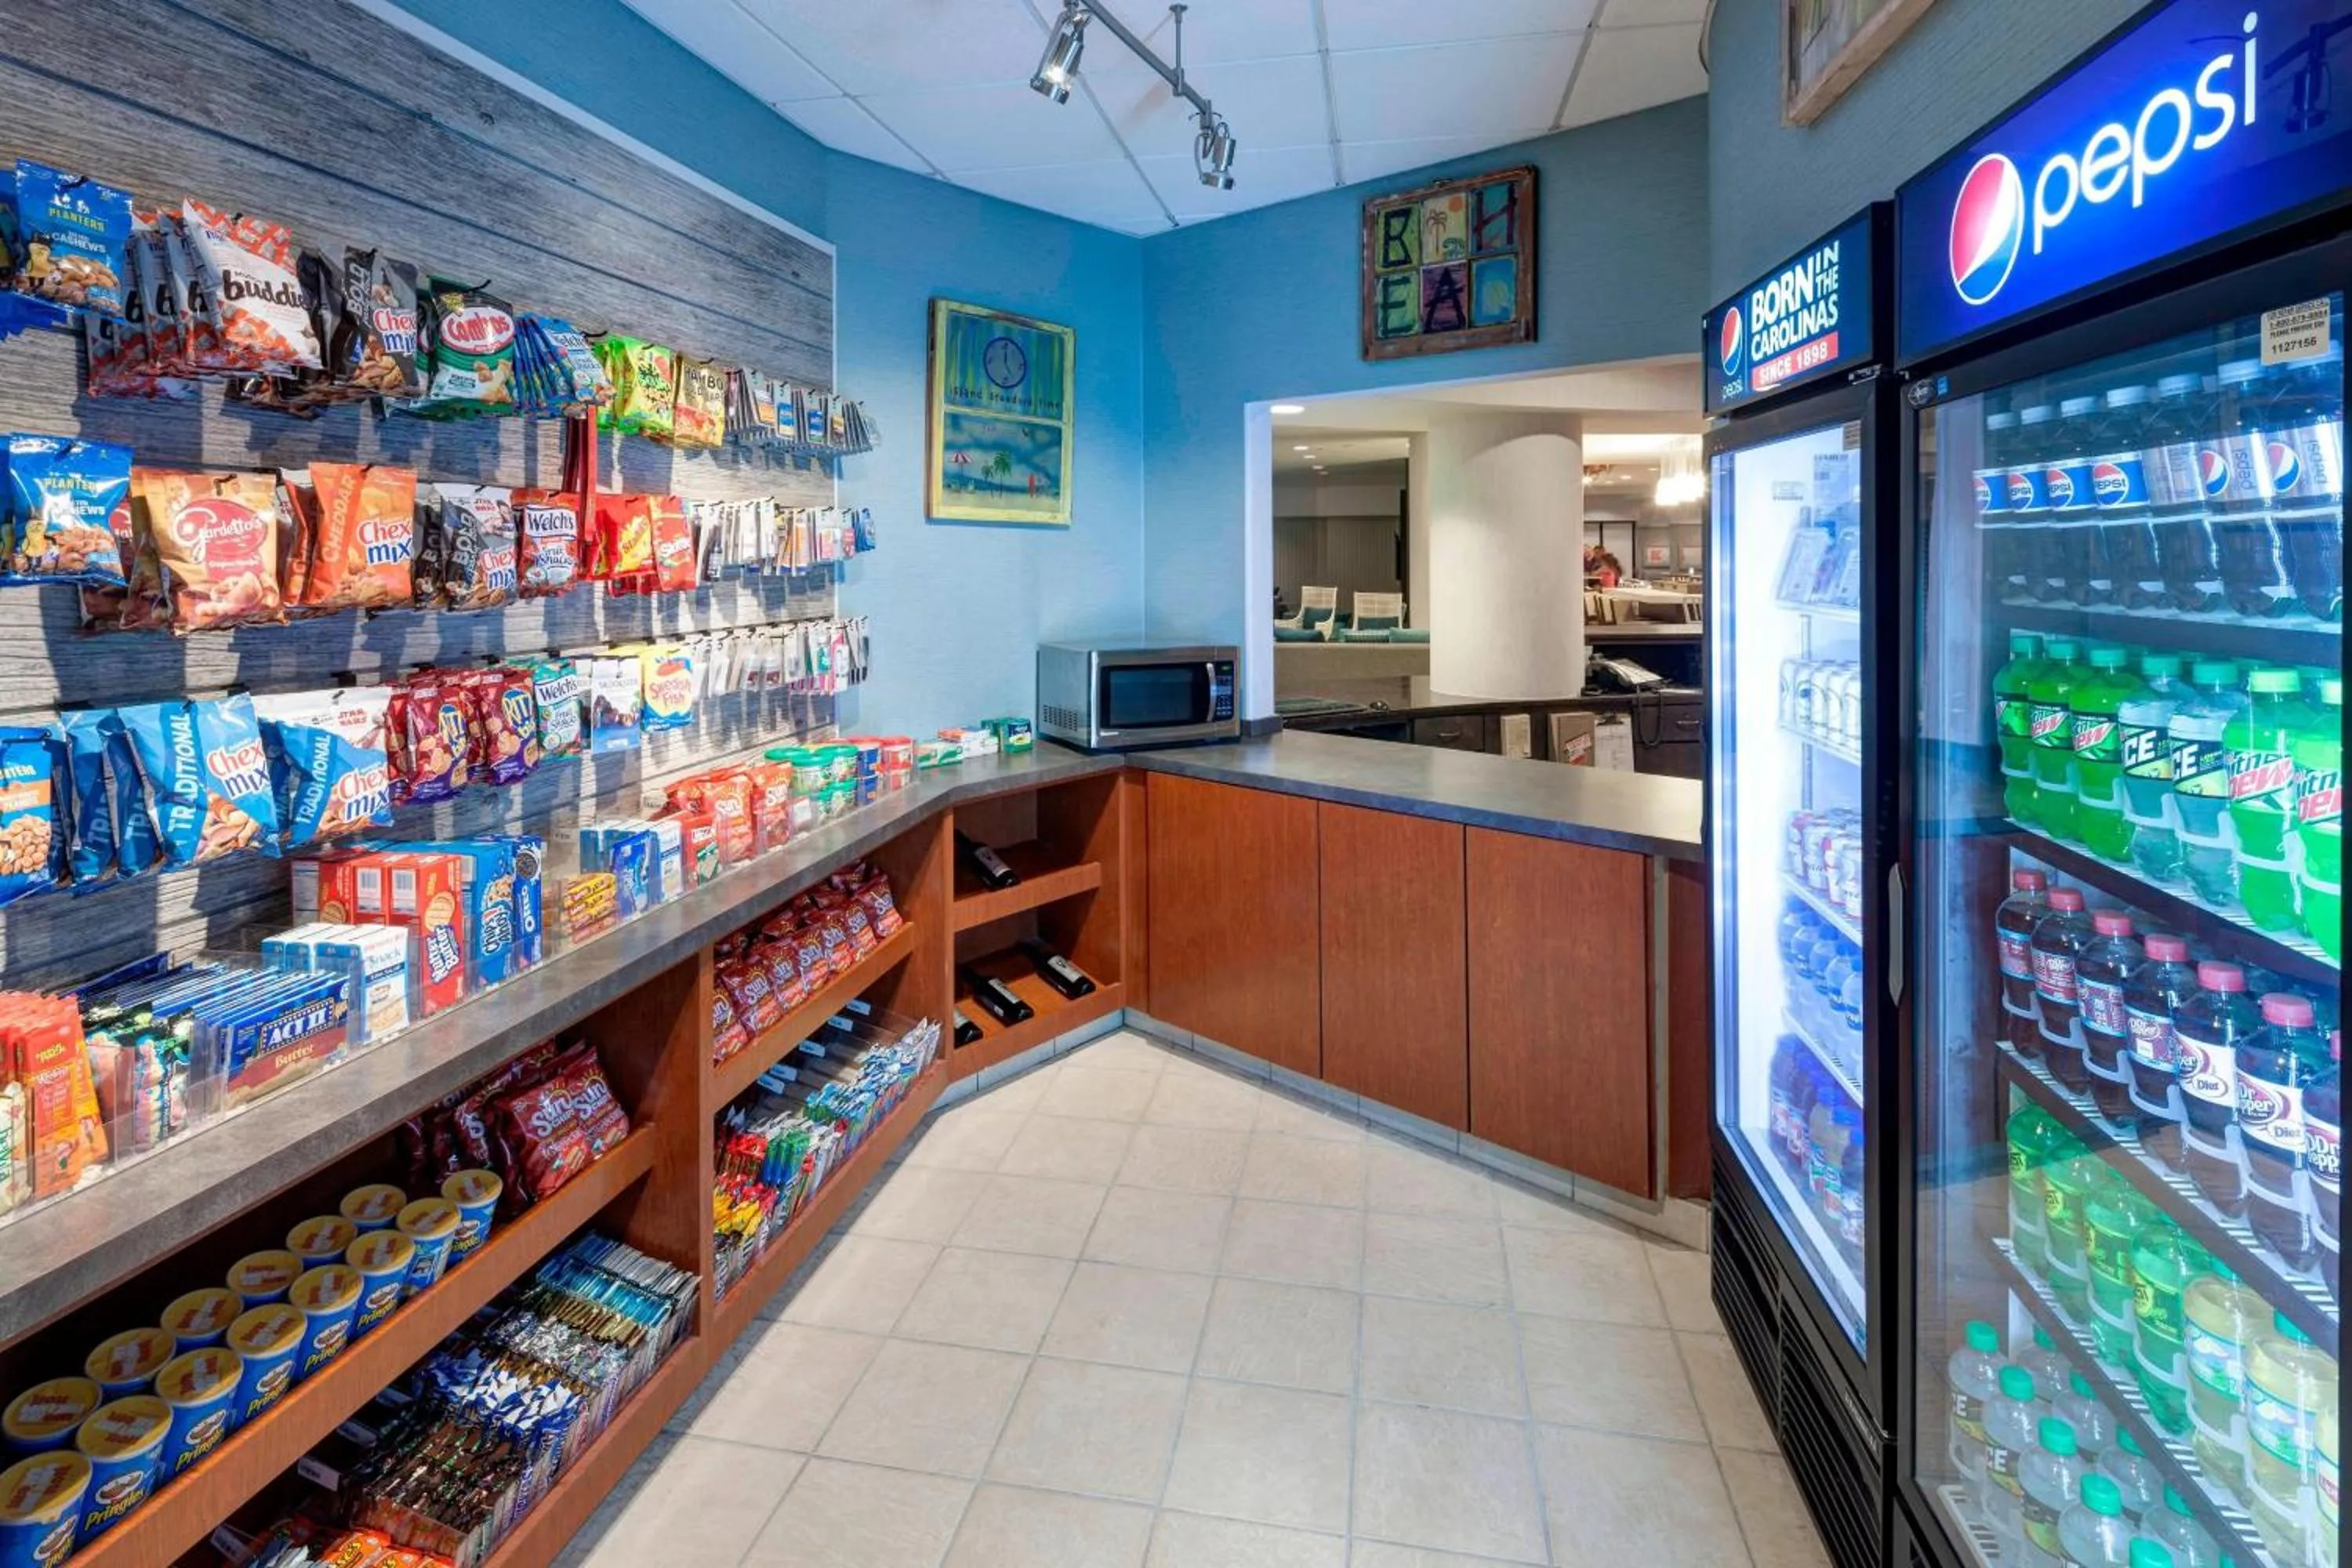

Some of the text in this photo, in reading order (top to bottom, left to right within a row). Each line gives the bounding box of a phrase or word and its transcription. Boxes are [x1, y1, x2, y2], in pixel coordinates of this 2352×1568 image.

[2033, 12, 2259, 255] pepsi
[49, 206, 106, 234] PLANTERS
[51, 232, 107, 253] CASHEWS
[222, 269, 310, 309] buddi
[346, 263, 365, 315] BOLD
[1751, 240, 1840, 333] BORN IN
[1817, 265, 1838, 297] THE
[374, 309, 416, 332] Chex
[447, 312, 510, 342] Combos
[1751, 293, 1838, 361] CAROLINAS
[1759, 341, 1828, 384] SINCE 1898
[2235, 448, 2257, 491] pepsi
[321, 474, 357, 563] CHEDDAR
[358, 520, 412, 545] Chex
[527, 511, 575, 532] Welch's
[366, 539, 412, 565] mix
[539, 676, 578, 702] Welch's
[649, 677, 691, 699] Swedish
[208, 741, 265, 778] Chex
[2122, 730, 2156, 767] CE
[2170, 745, 2198, 782] CE
[168, 713, 191, 834] TRADITIONAL
[226, 765, 269, 798] mix
[339, 768, 390, 801] Chex
[345, 787, 390, 821] mix
[426, 937, 448, 983] Nutter
[435, 927, 460, 970] Butter
[744, 975, 771, 1004] Sun
[269, 1014, 306, 1045] ACT
[275, 1044, 315, 1069] Butter
[572, 1083, 608, 1120] Sun
[2197, 1079, 2220, 1091] Diet
[532, 1096, 572, 1137] Sun
[2274, 1126, 2302, 1138] Diet
